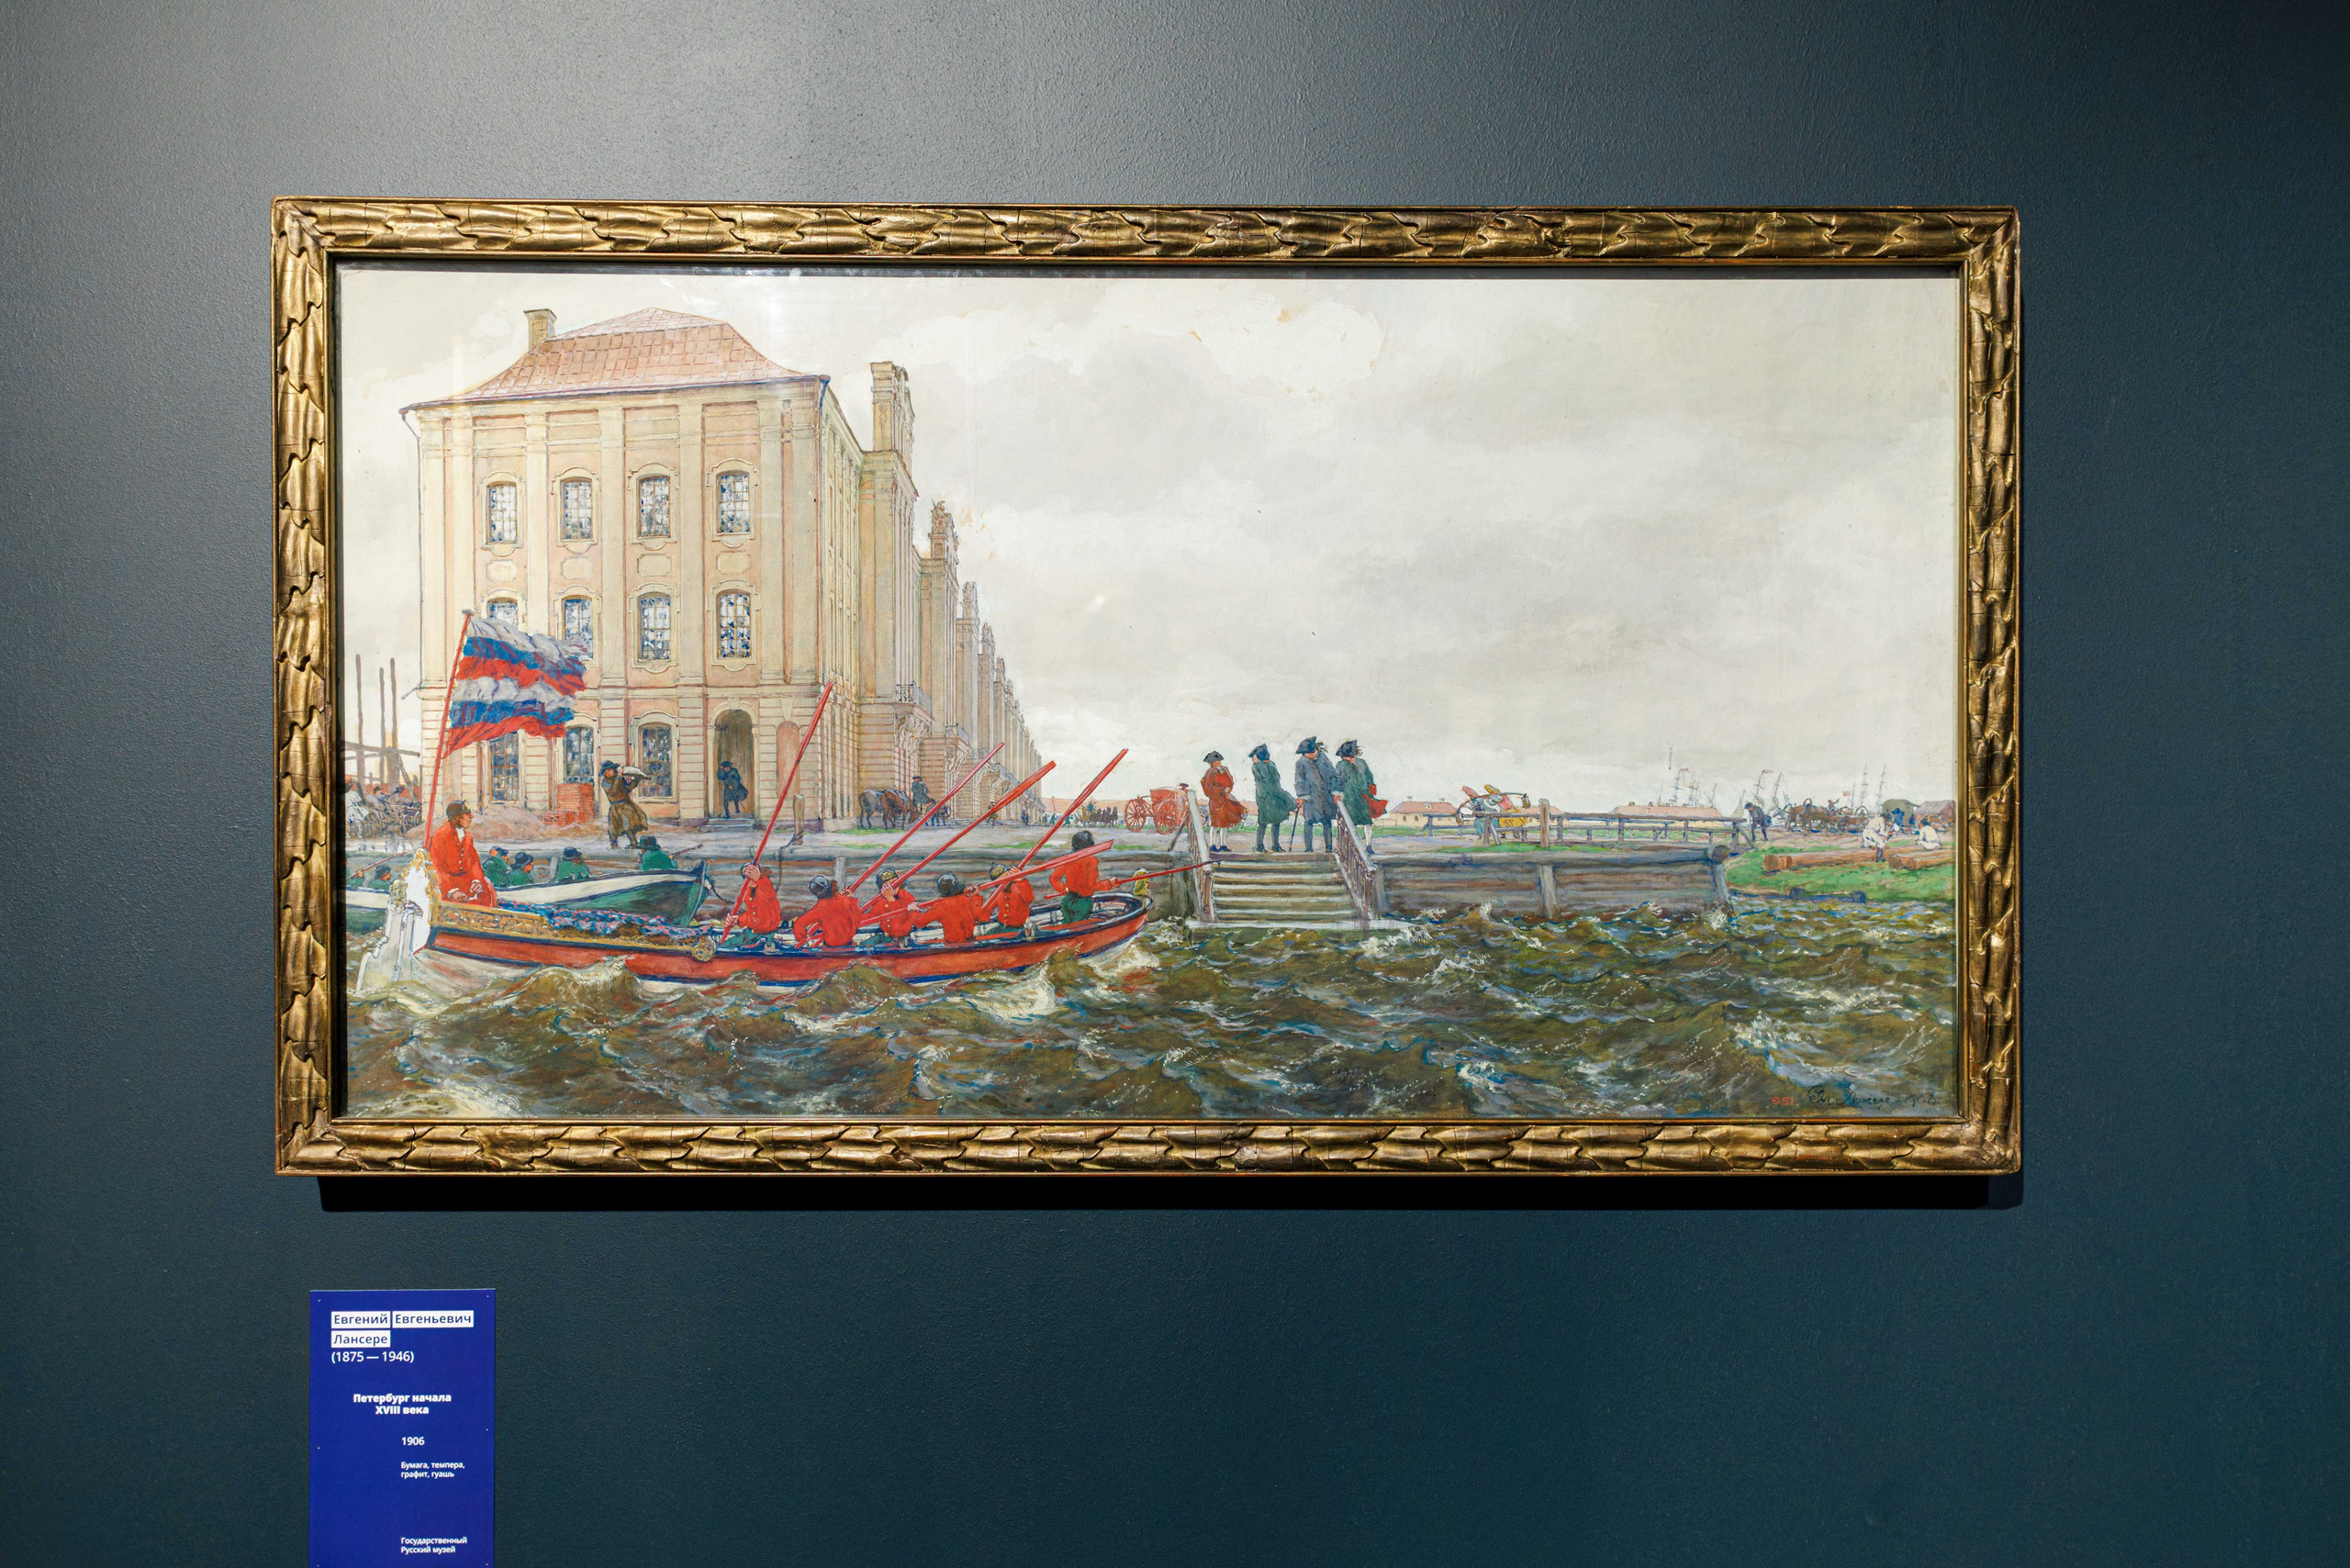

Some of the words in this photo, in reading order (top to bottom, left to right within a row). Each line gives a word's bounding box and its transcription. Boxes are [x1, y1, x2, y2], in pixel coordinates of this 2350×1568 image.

[334, 1314, 388, 1325] Евгений
[395, 1313, 472, 1324] Евгеньевич
[333, 1334, 388, 1347] Лансере
[330, 1350, 364, 1364] (1875
[382, 1350, 415, 1363] 1946)
[353, 1394, 410, 1405] Петербург
[412, 1394, 452, 1403] начала
[402, 1406, 430, 1415] века
[401, 1437, 425, 1446] 1906
[400, 1462, 430, 1471] Бумага,
[431, 1462, 465, 1471] темпера,
[400, 1471, 430, 1480] графит,
[431, 1471, 455, 1480] гуашь
[400, 1537, 468, 1546] Государственный
[400, 1546, 431, 1555] Русский
[432, 1546, 456, 1555] музей
